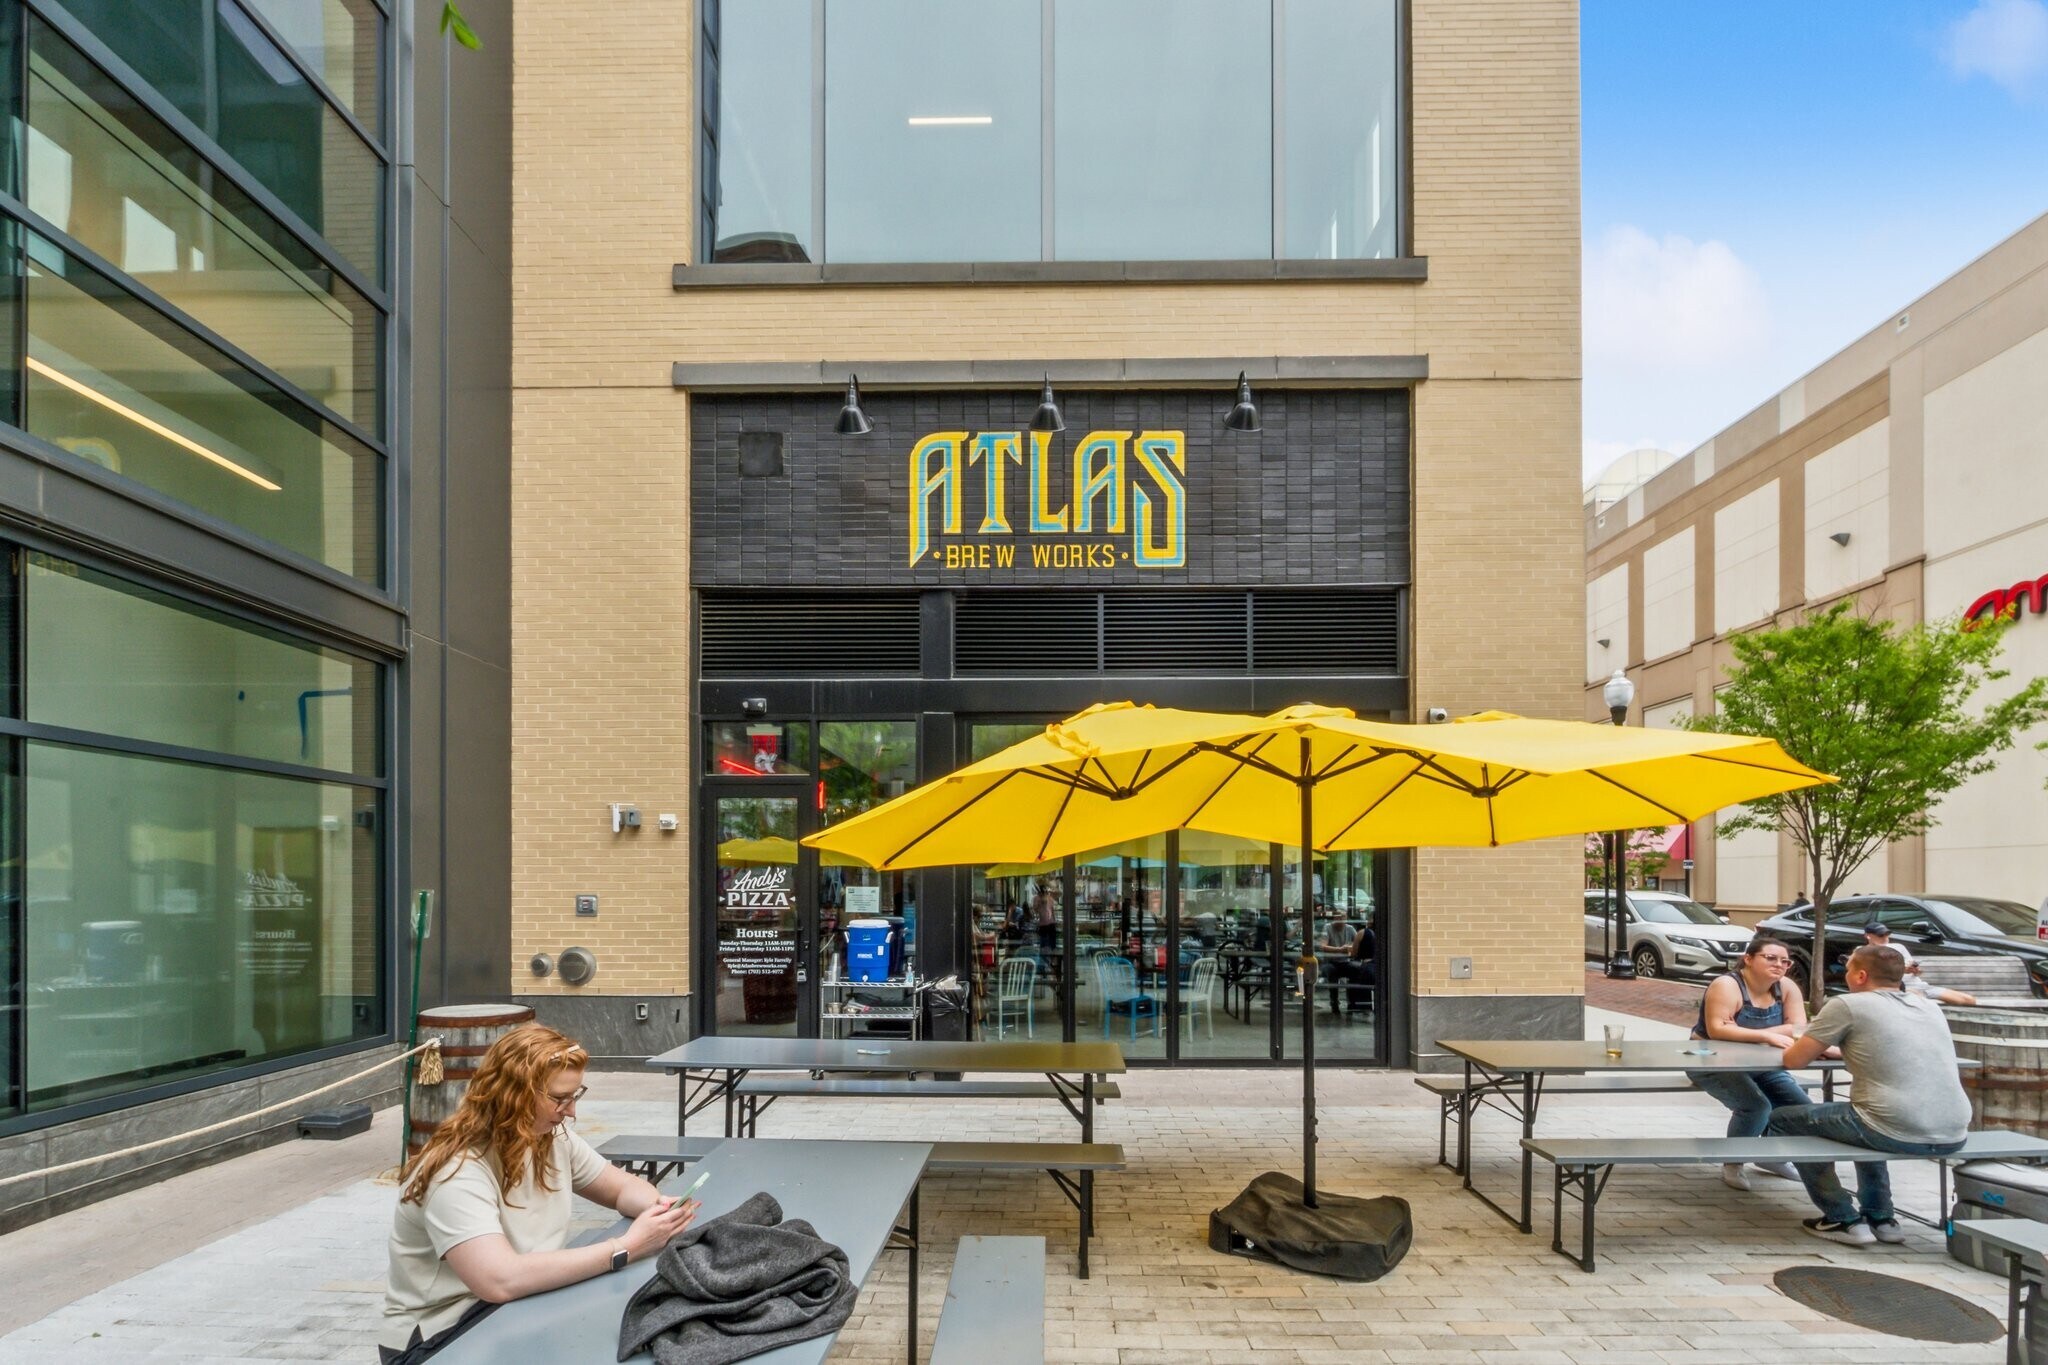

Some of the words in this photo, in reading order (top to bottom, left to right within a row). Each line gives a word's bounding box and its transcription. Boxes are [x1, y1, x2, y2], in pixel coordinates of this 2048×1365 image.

[909, 430, 1186, 568] ATLAS
[946, 544, 1015, 568] BREW
[1032, 544, 1115, 568] WORKS
[732, 866, 786, 892] Andy's
[727, 892, 789, 906] PIZZA
[736, 928, 778, 938] Hours:
